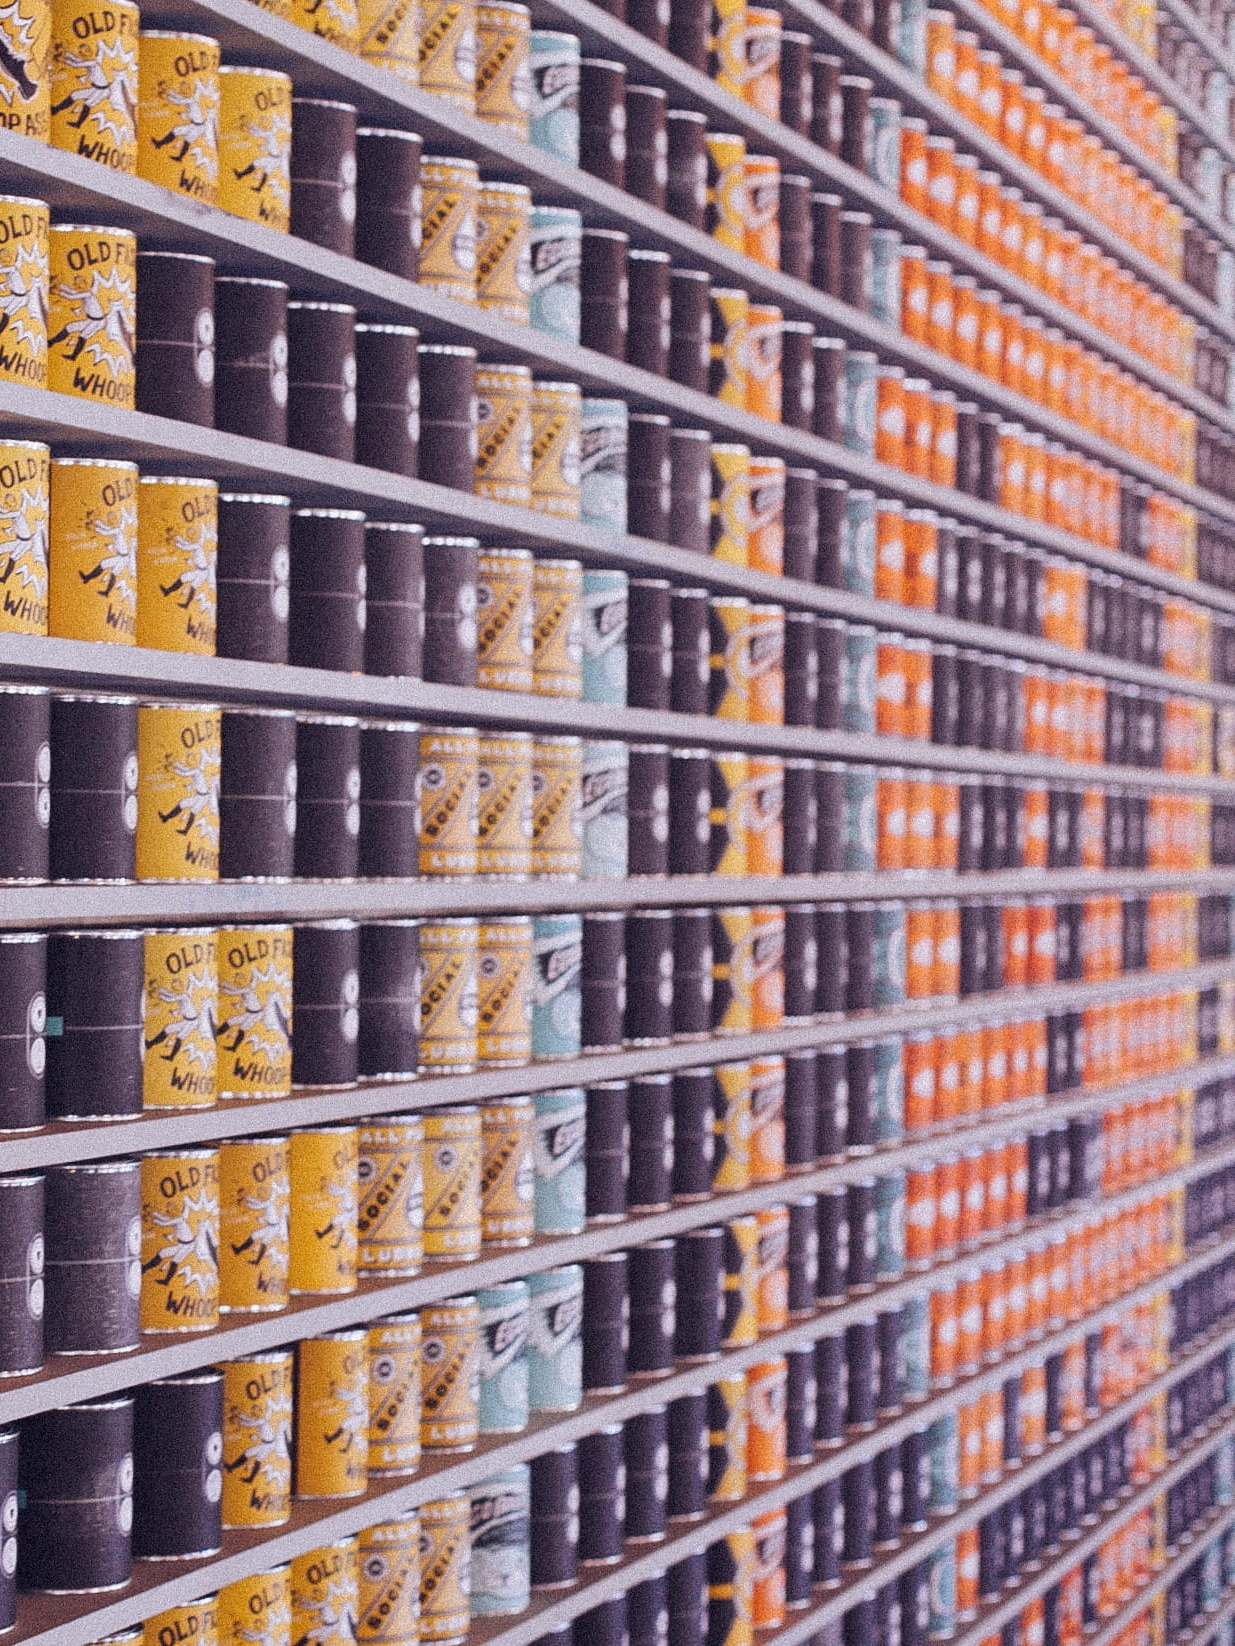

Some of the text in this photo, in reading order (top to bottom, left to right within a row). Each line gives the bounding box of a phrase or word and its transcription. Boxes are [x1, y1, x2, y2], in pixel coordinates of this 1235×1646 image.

[72, 11, 115, 38] OLD
[67, 241, 111, 270] OLD
[166, 942, 202, 974] OLD
[227, 939, 268, 968] OLD
[159, 1166, 200, 1198] OLD
